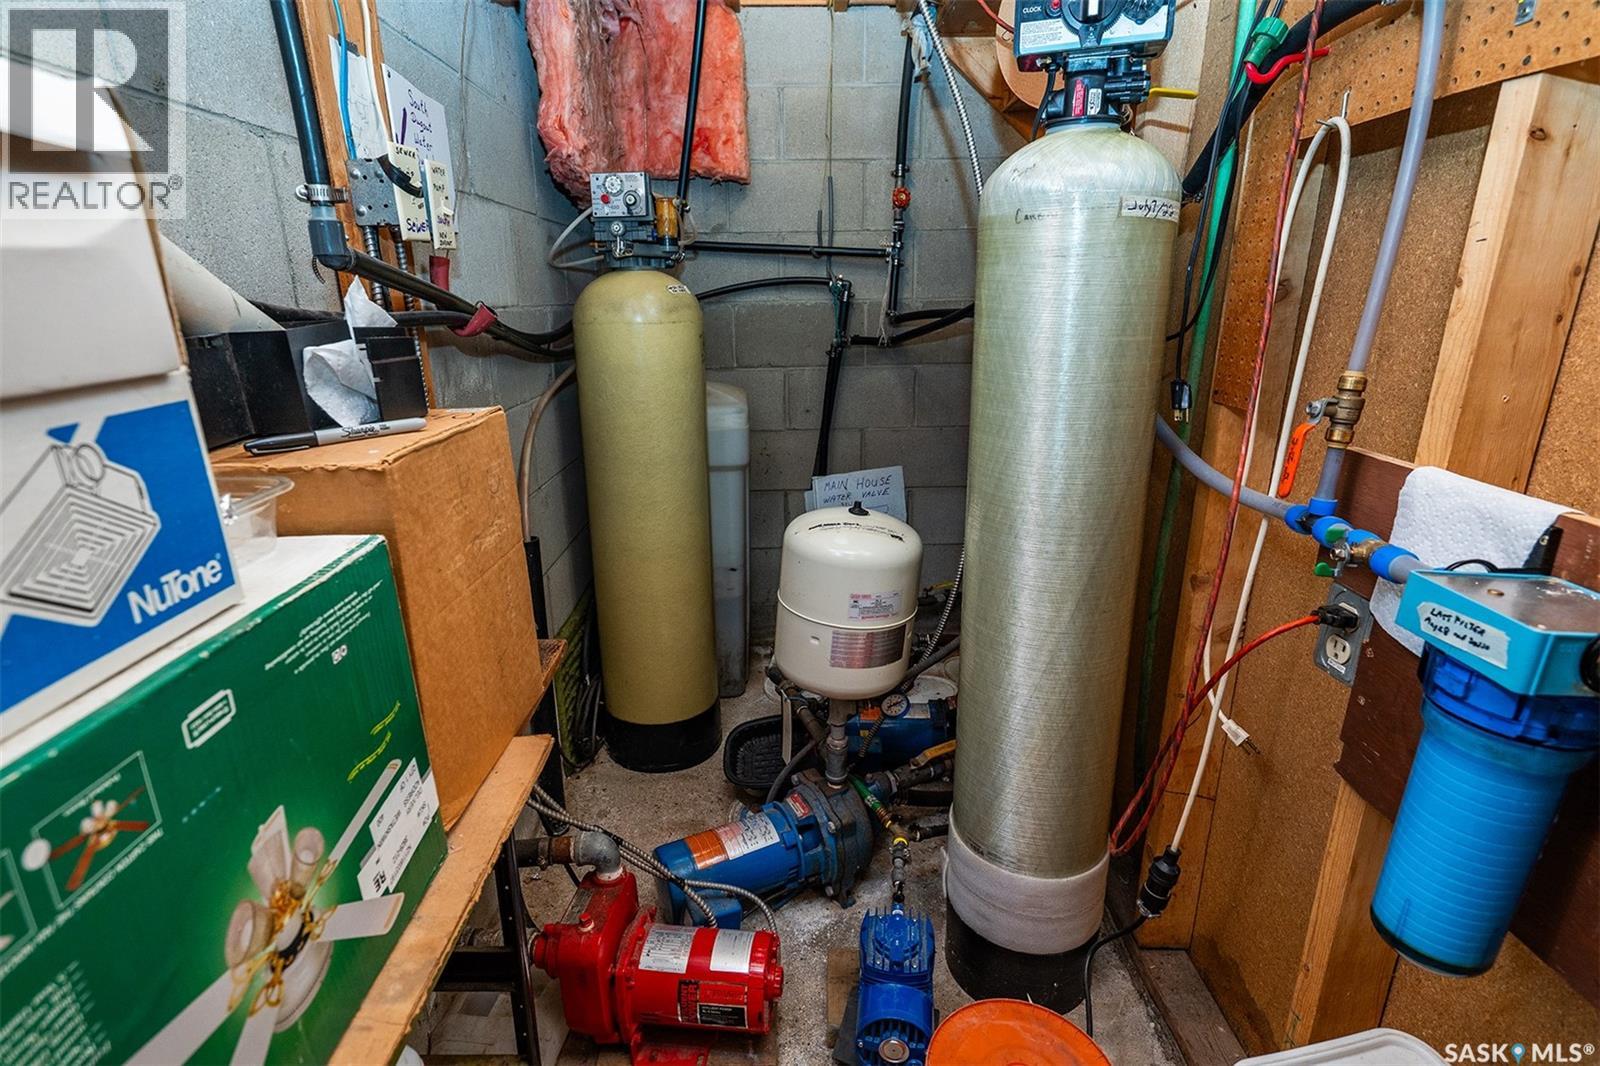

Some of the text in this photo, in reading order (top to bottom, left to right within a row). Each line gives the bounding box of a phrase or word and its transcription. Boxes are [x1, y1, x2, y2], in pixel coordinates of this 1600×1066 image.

[1022, 6, 1041, 14] CLOCK
[341, 424, 380, 438] Sharpie
[823, 474, 893, 492] MAIN HOUSE
[823, 487, 890, 504] WATER VALVE
[127, 559, 223, 625] NuTone
[1454, 616, 1486, 638] FILTER
